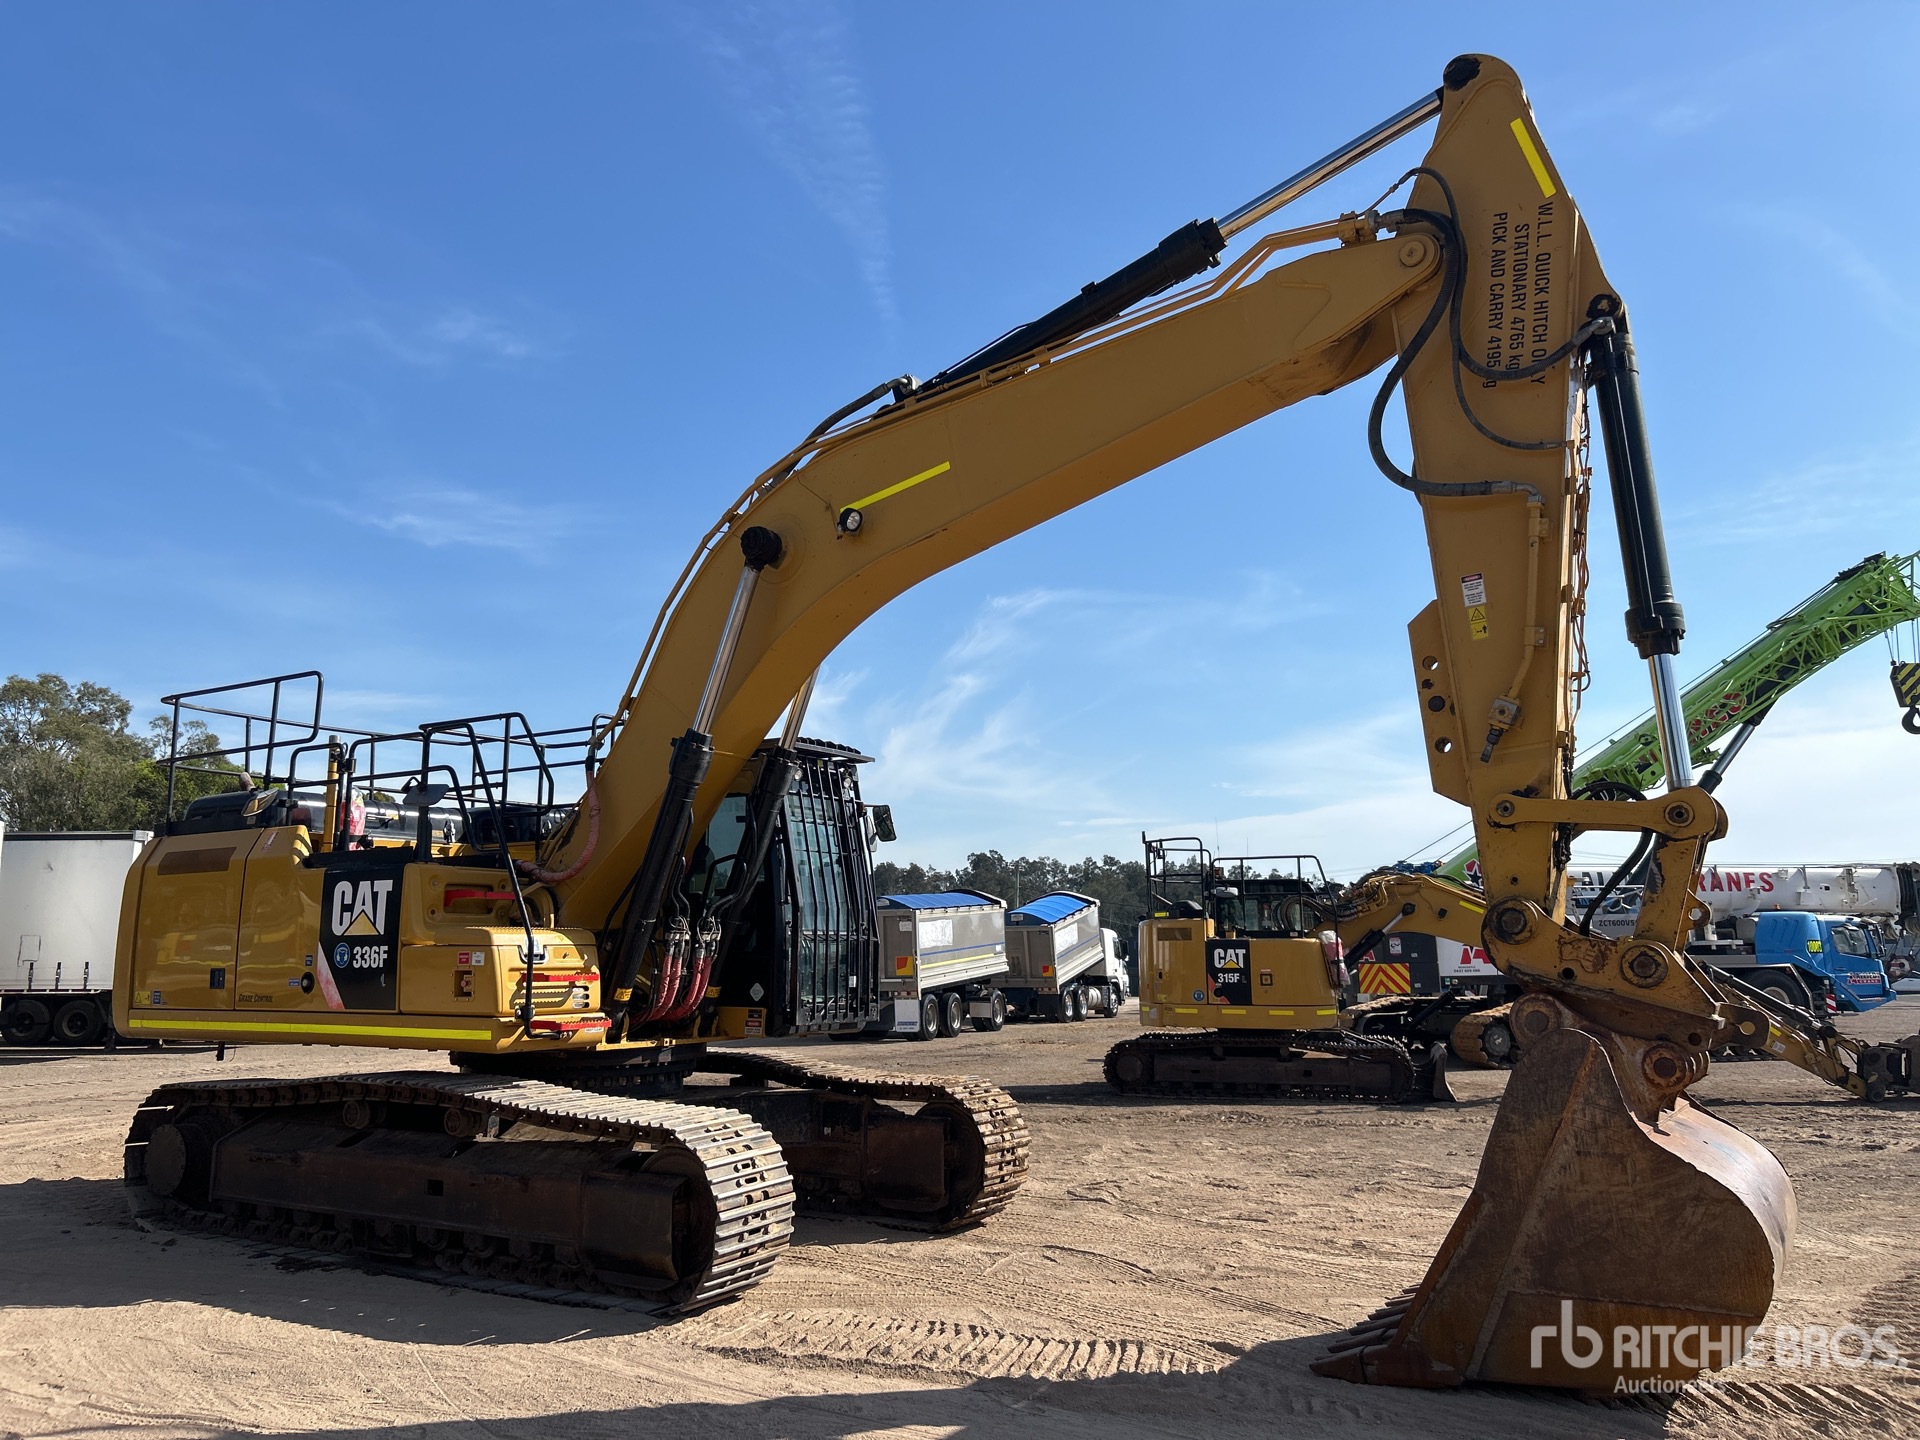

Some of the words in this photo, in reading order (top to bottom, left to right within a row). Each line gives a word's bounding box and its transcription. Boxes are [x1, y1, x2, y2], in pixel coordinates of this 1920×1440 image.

[1492, 212, 1508, 245] PICK
[1490, 249, 1506, 279] AND
[1511, 223, 1530, 312] STATIONARY
[1534, 252, 1551, 297] QUICK
[1488, 283, 1505, 331] CARRY
[1532, 300, 1549, 344] HITCH
[1509, 316, 1526, 351] 4765
[1486, 336, 1502, 368] 4195
[1505, 352, 1524, 372] kg
[1530, 348, 1547, 385] OY
[331, 879, 393, 937] CAT
[352, 945, 388, 969] 336F
[1213, 948, 1246, 968] CAT
[1217, 973, 1240, 983] 315F
